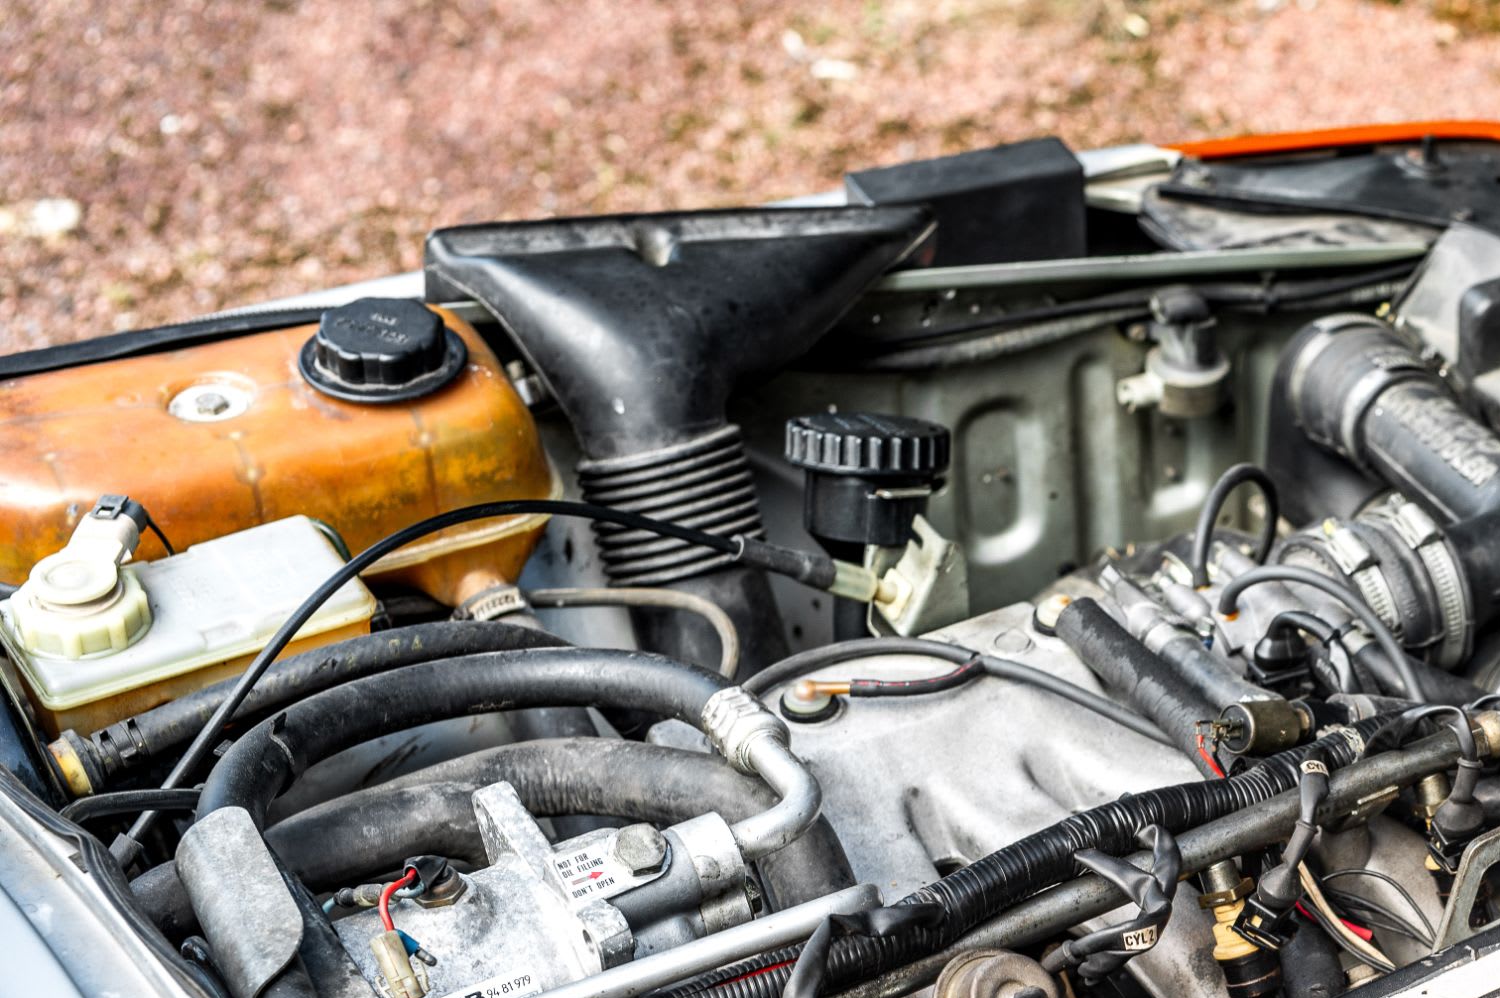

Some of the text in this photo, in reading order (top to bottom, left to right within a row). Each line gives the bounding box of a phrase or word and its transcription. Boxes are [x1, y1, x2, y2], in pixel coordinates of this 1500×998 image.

[557, 853, 589, 870] NOT FOR
[562, 857, 604, 879] OIL FILLING
[572, 877, 615, 899] DON'T OPEN
[1125, 930, 1154, 946] CYL 2
